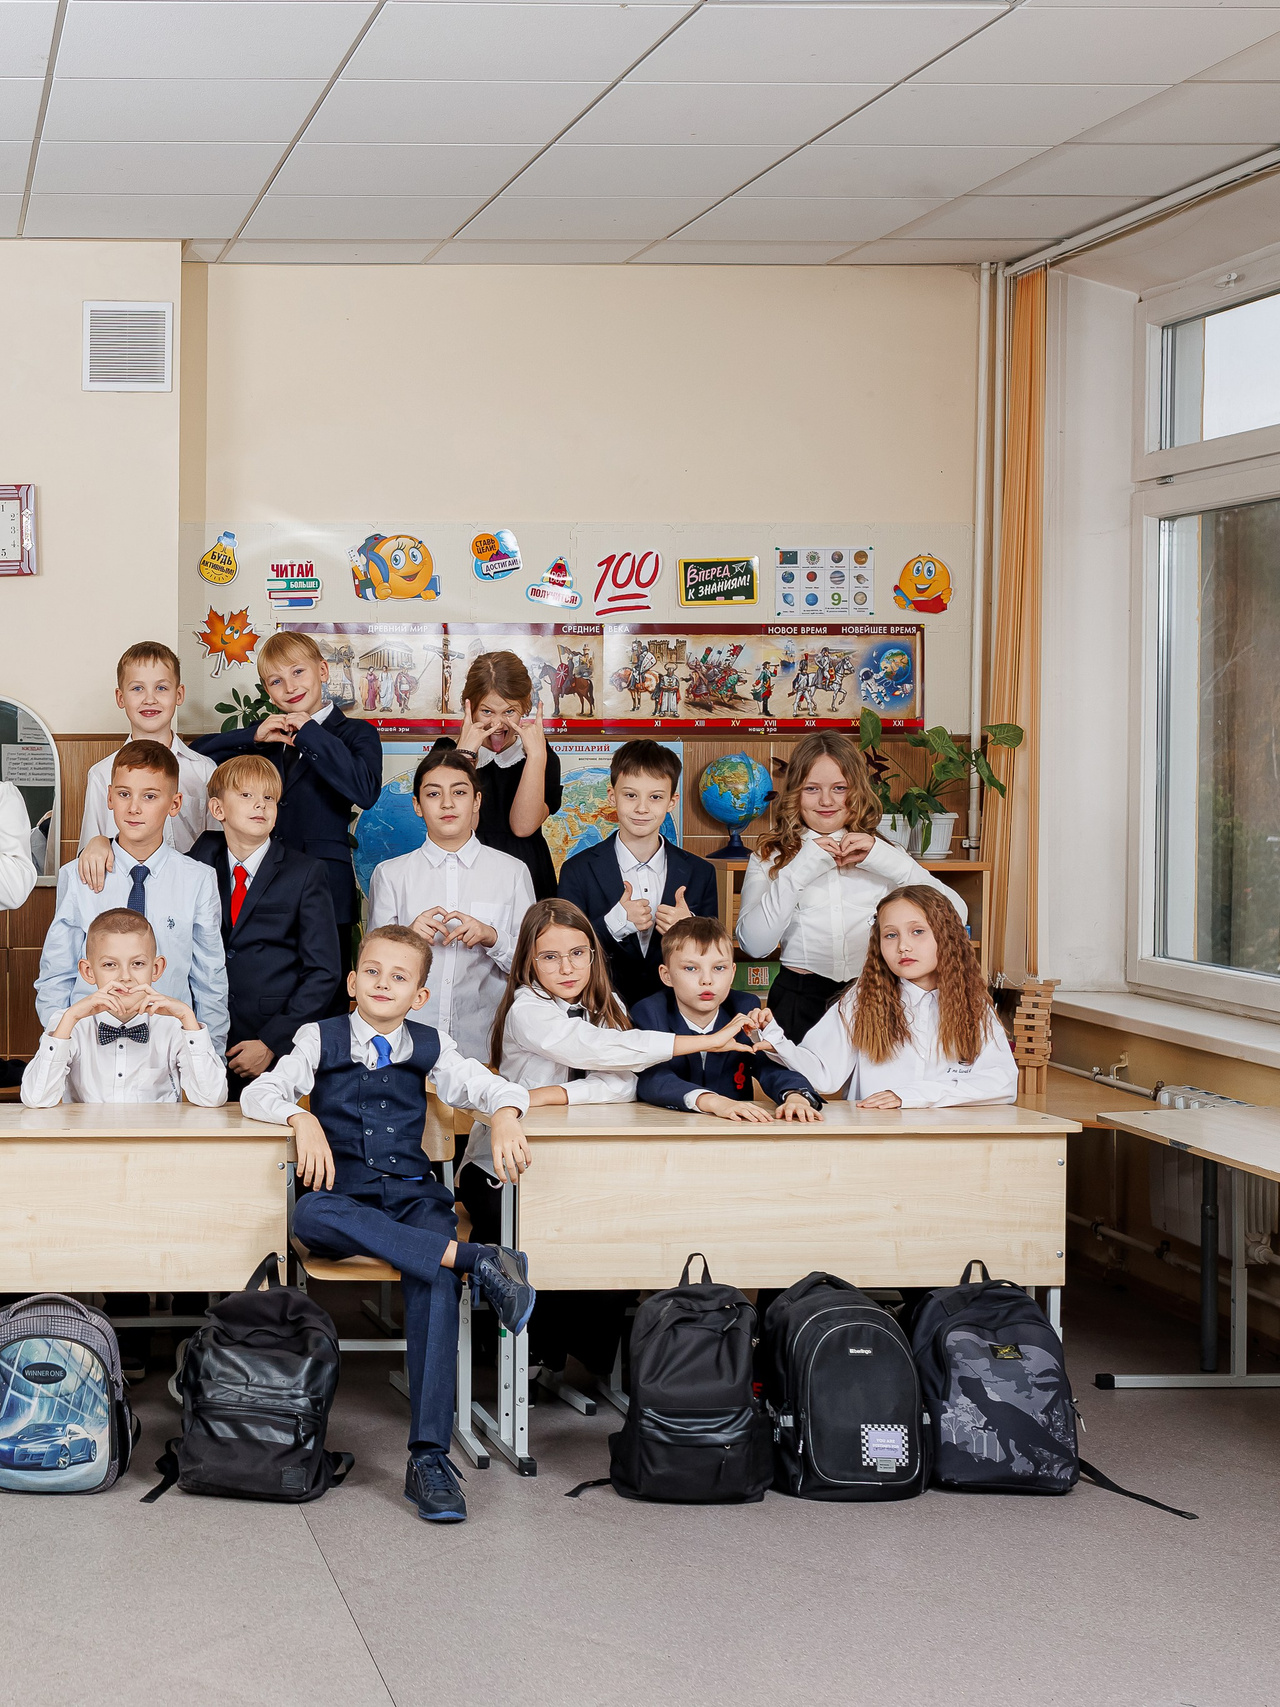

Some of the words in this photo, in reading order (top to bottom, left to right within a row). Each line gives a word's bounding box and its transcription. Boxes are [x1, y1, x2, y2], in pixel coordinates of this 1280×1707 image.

[10, 513, 15, 521] 2
[10, 526, 16, 534] 3
[475, 538, 496, 548] СТАВЬ
[476, 544, 496, 555] ЦЕЛИ!
[210, 551, 233, 566] БУДЬ
[271, 560, 314, 578] ЧИТАЙ
[485, 558, 519, 573] ДОСТИГАЙ!
[594, 551, 659, 602] 100
[289, 581, 319, 589] БОЛЬШЕ!
[688, 588, 695, 600] К
[698, 574, 751, 597] ЗНАНИЯМ!
[368, 624, 407, 633] ДРЕВНИЙ
[562, 625, 600, 634] СРЕДНИЕ
[608, 625, 630, 633] ВЕКА
[768, 626, 798, 634] НОВОЕ
[801, 626, 828, 634] ВРЕМЯ
[841, 624, 887, 634] НОВЕЙШЕЕ
[890, 626, 917, 634] ВРЕМЯ
